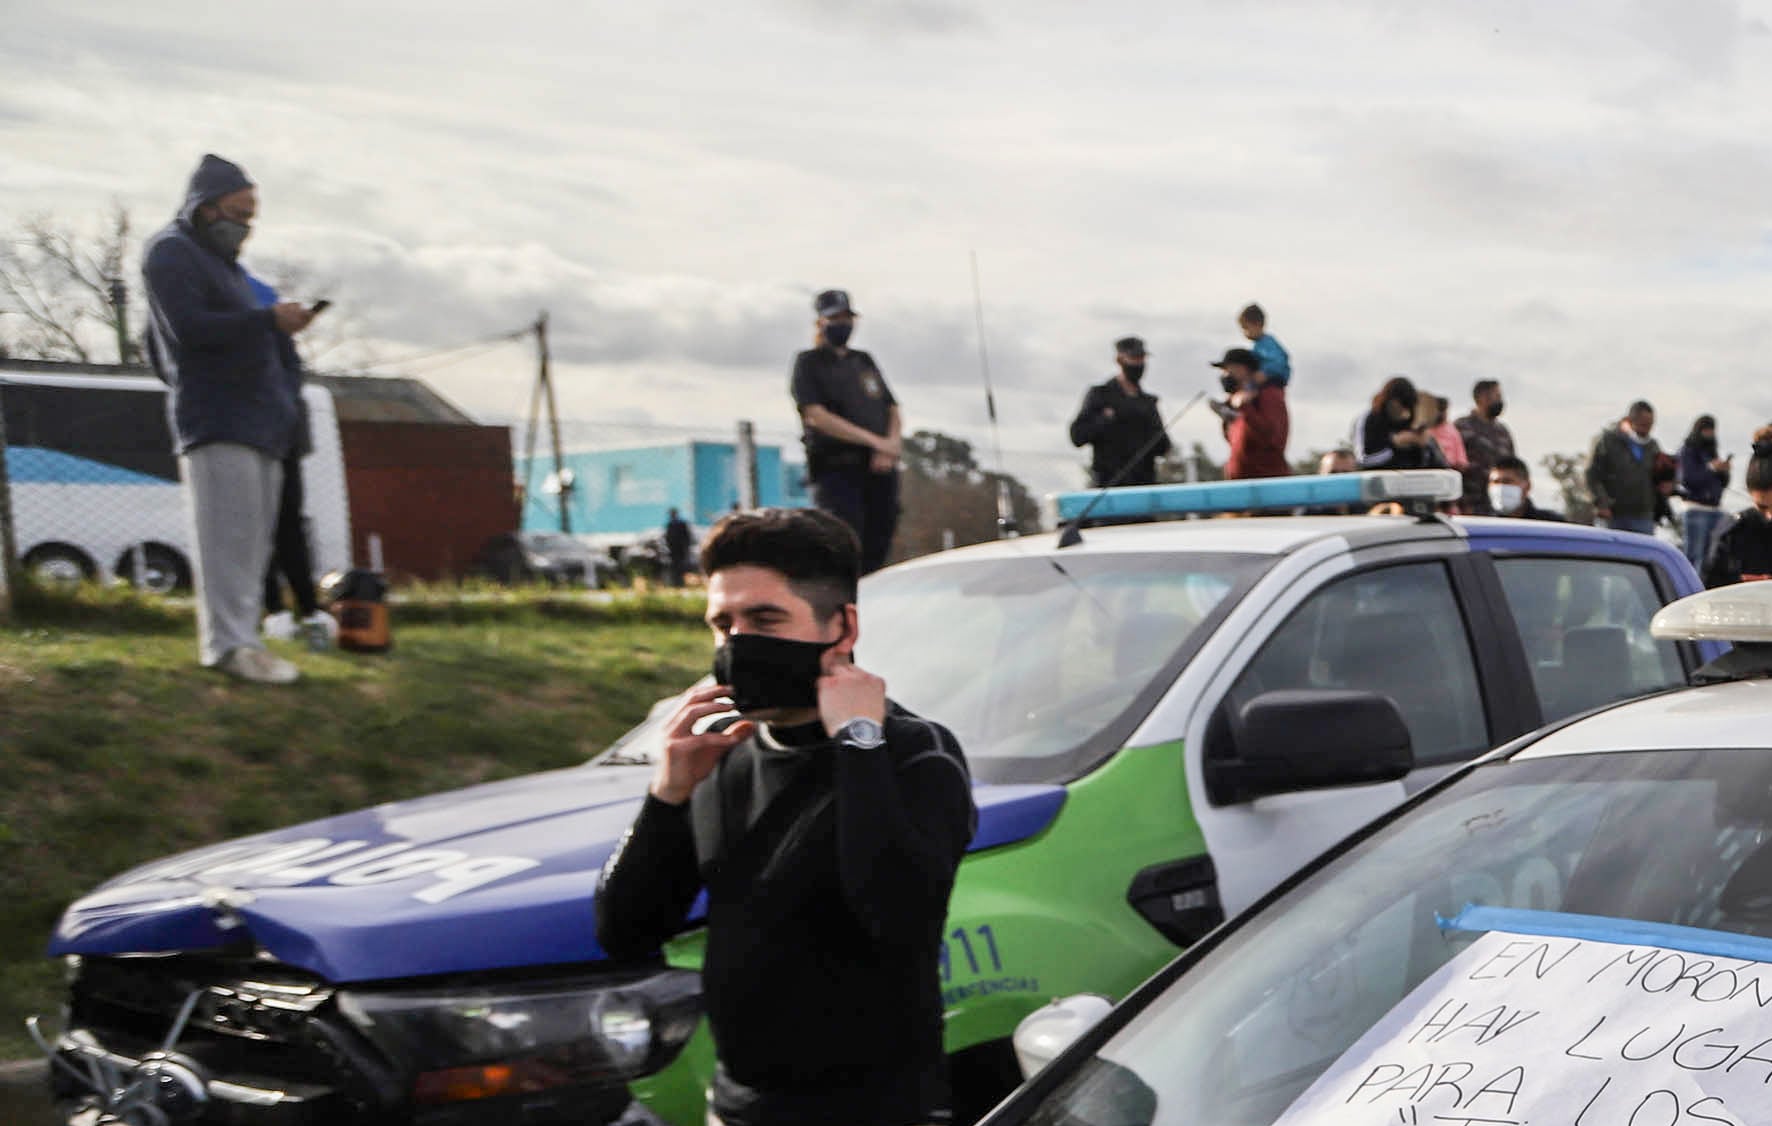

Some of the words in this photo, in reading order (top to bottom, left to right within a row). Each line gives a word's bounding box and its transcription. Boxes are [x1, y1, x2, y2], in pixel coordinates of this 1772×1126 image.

[1468, 941, 1582, 980] EN
[1407, 998, 1541, 1046] HAY
[1345, 1061, 1525, 1115] PARA
